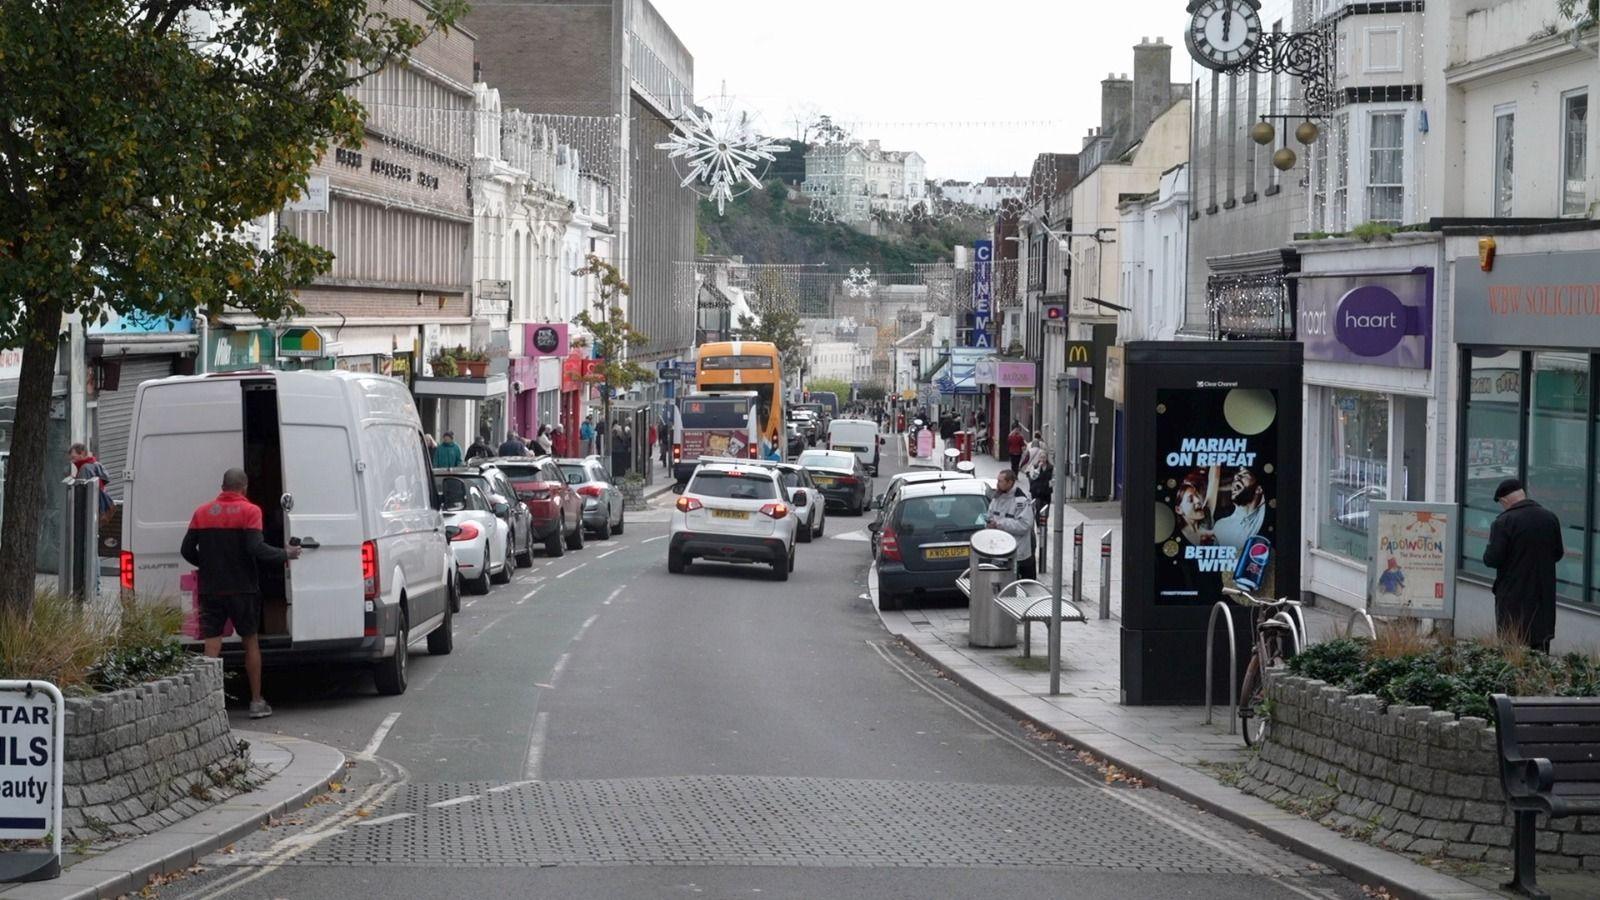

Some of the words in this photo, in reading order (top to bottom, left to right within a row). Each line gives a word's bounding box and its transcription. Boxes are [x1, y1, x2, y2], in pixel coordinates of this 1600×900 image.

[976, 246, 990, 348] CINEMA
[1488, 286, 1520, 315] WBW
[1302, 301, 1326, 335] haart
[1345, 310, 1397, 328] haart
[1181, 438, 1247, 452] MARIAH
[1166, 453, 1192, 467] ON
[1196, 453, 1256, 467] REPEAT
[1184, 546, 1236, 559] BETTER
[1380, 536, 1442, 554] PADDINGTON
[1198, 559, 1237, 572] WITH
[0, 706, 49, 724] TAR
[0, 736, 48, 766] ILS
[0, 776, 47, 804] auty
